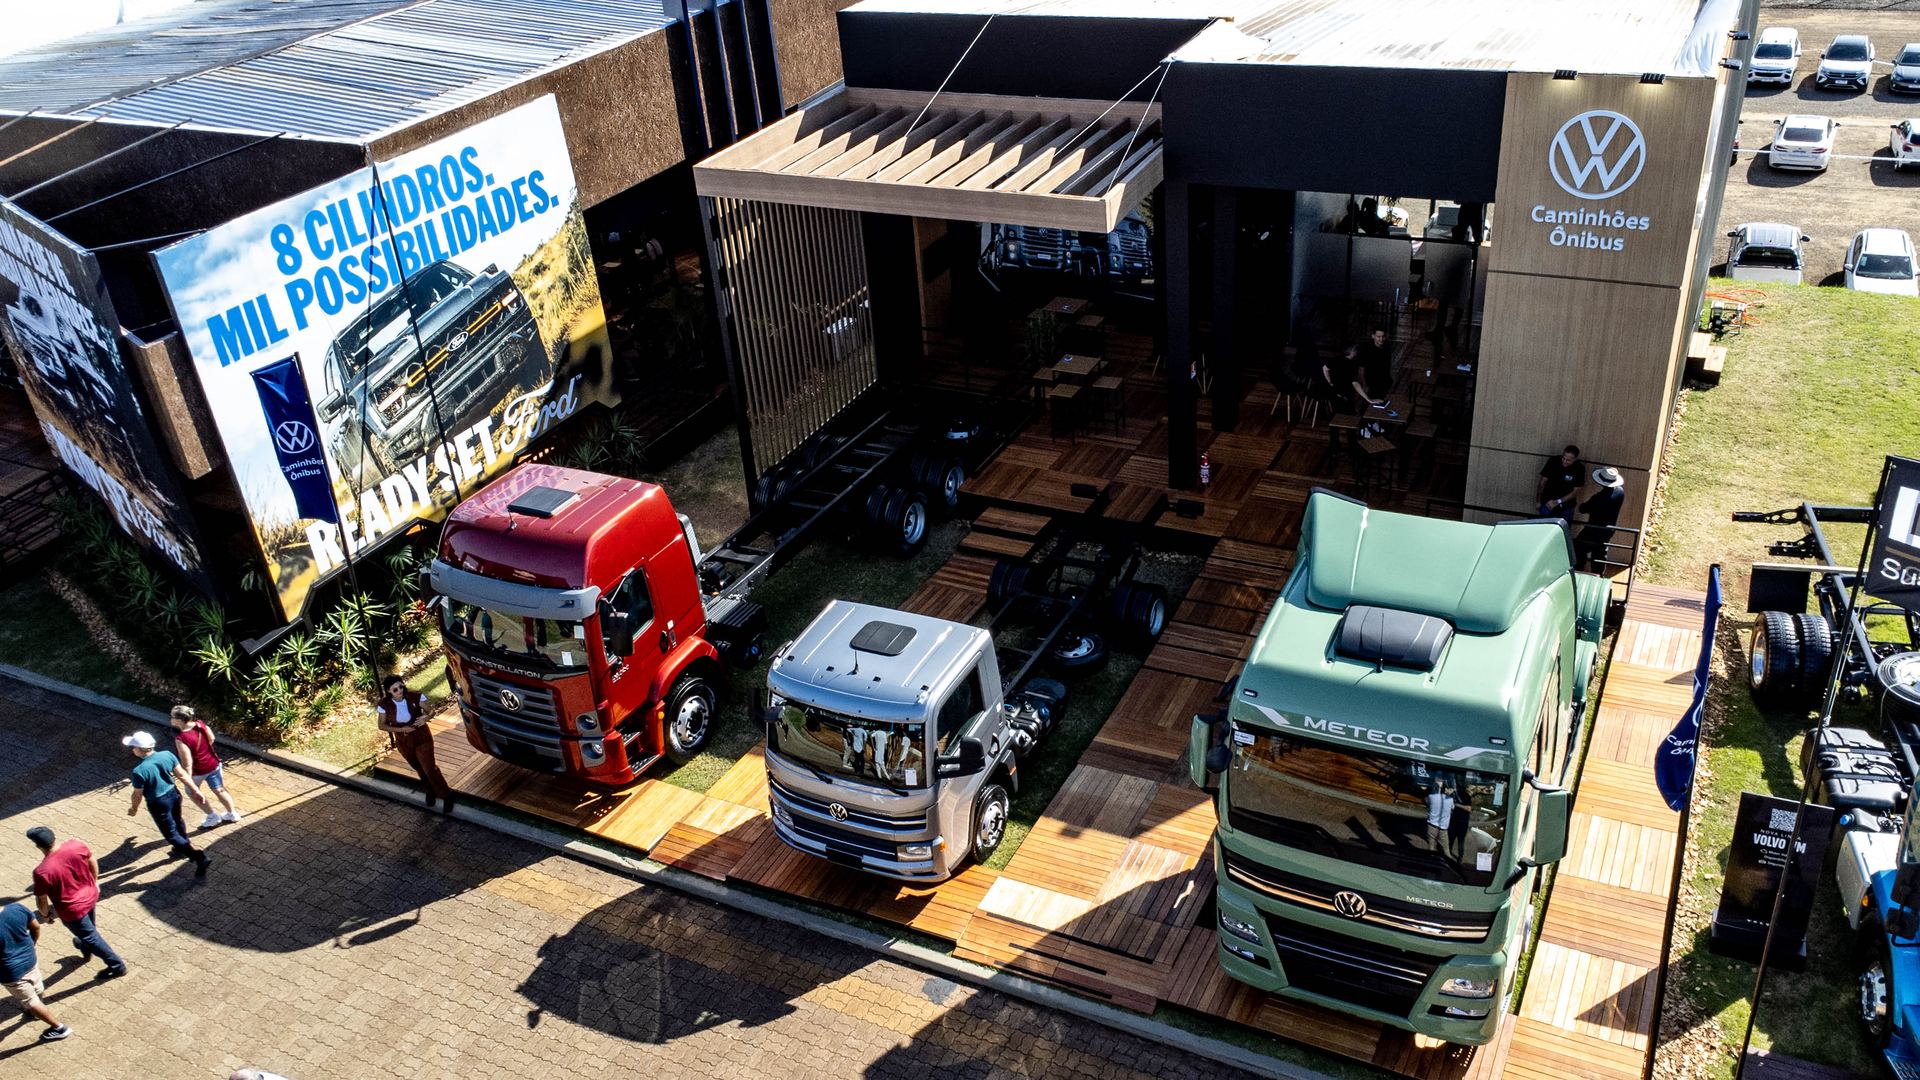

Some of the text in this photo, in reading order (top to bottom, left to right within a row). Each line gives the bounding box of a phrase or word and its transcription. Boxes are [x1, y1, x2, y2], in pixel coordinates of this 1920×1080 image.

[270, 146, 494, 276] 8 CILINDROS.
[1531, 204, 1651, 231] Caminhões
[1549, 225, 1625, 251] Ônibus
[206, 170, 560, 368] MIL POSSIBILIDADES.
[290, 468, 321, 481] Ônibus
[305, 454, 433, 575] READY
[433, 416, 500, 492] SET
[470, 656, 541, 679] CONSTELLATION
[1303, 715, 1430, 752] METEOR
[1753, 832, 1787, 850] VOLVO
[1759, 828, 1779, 837] NOVA
[1406, 895, 1454, 909] METEOR
